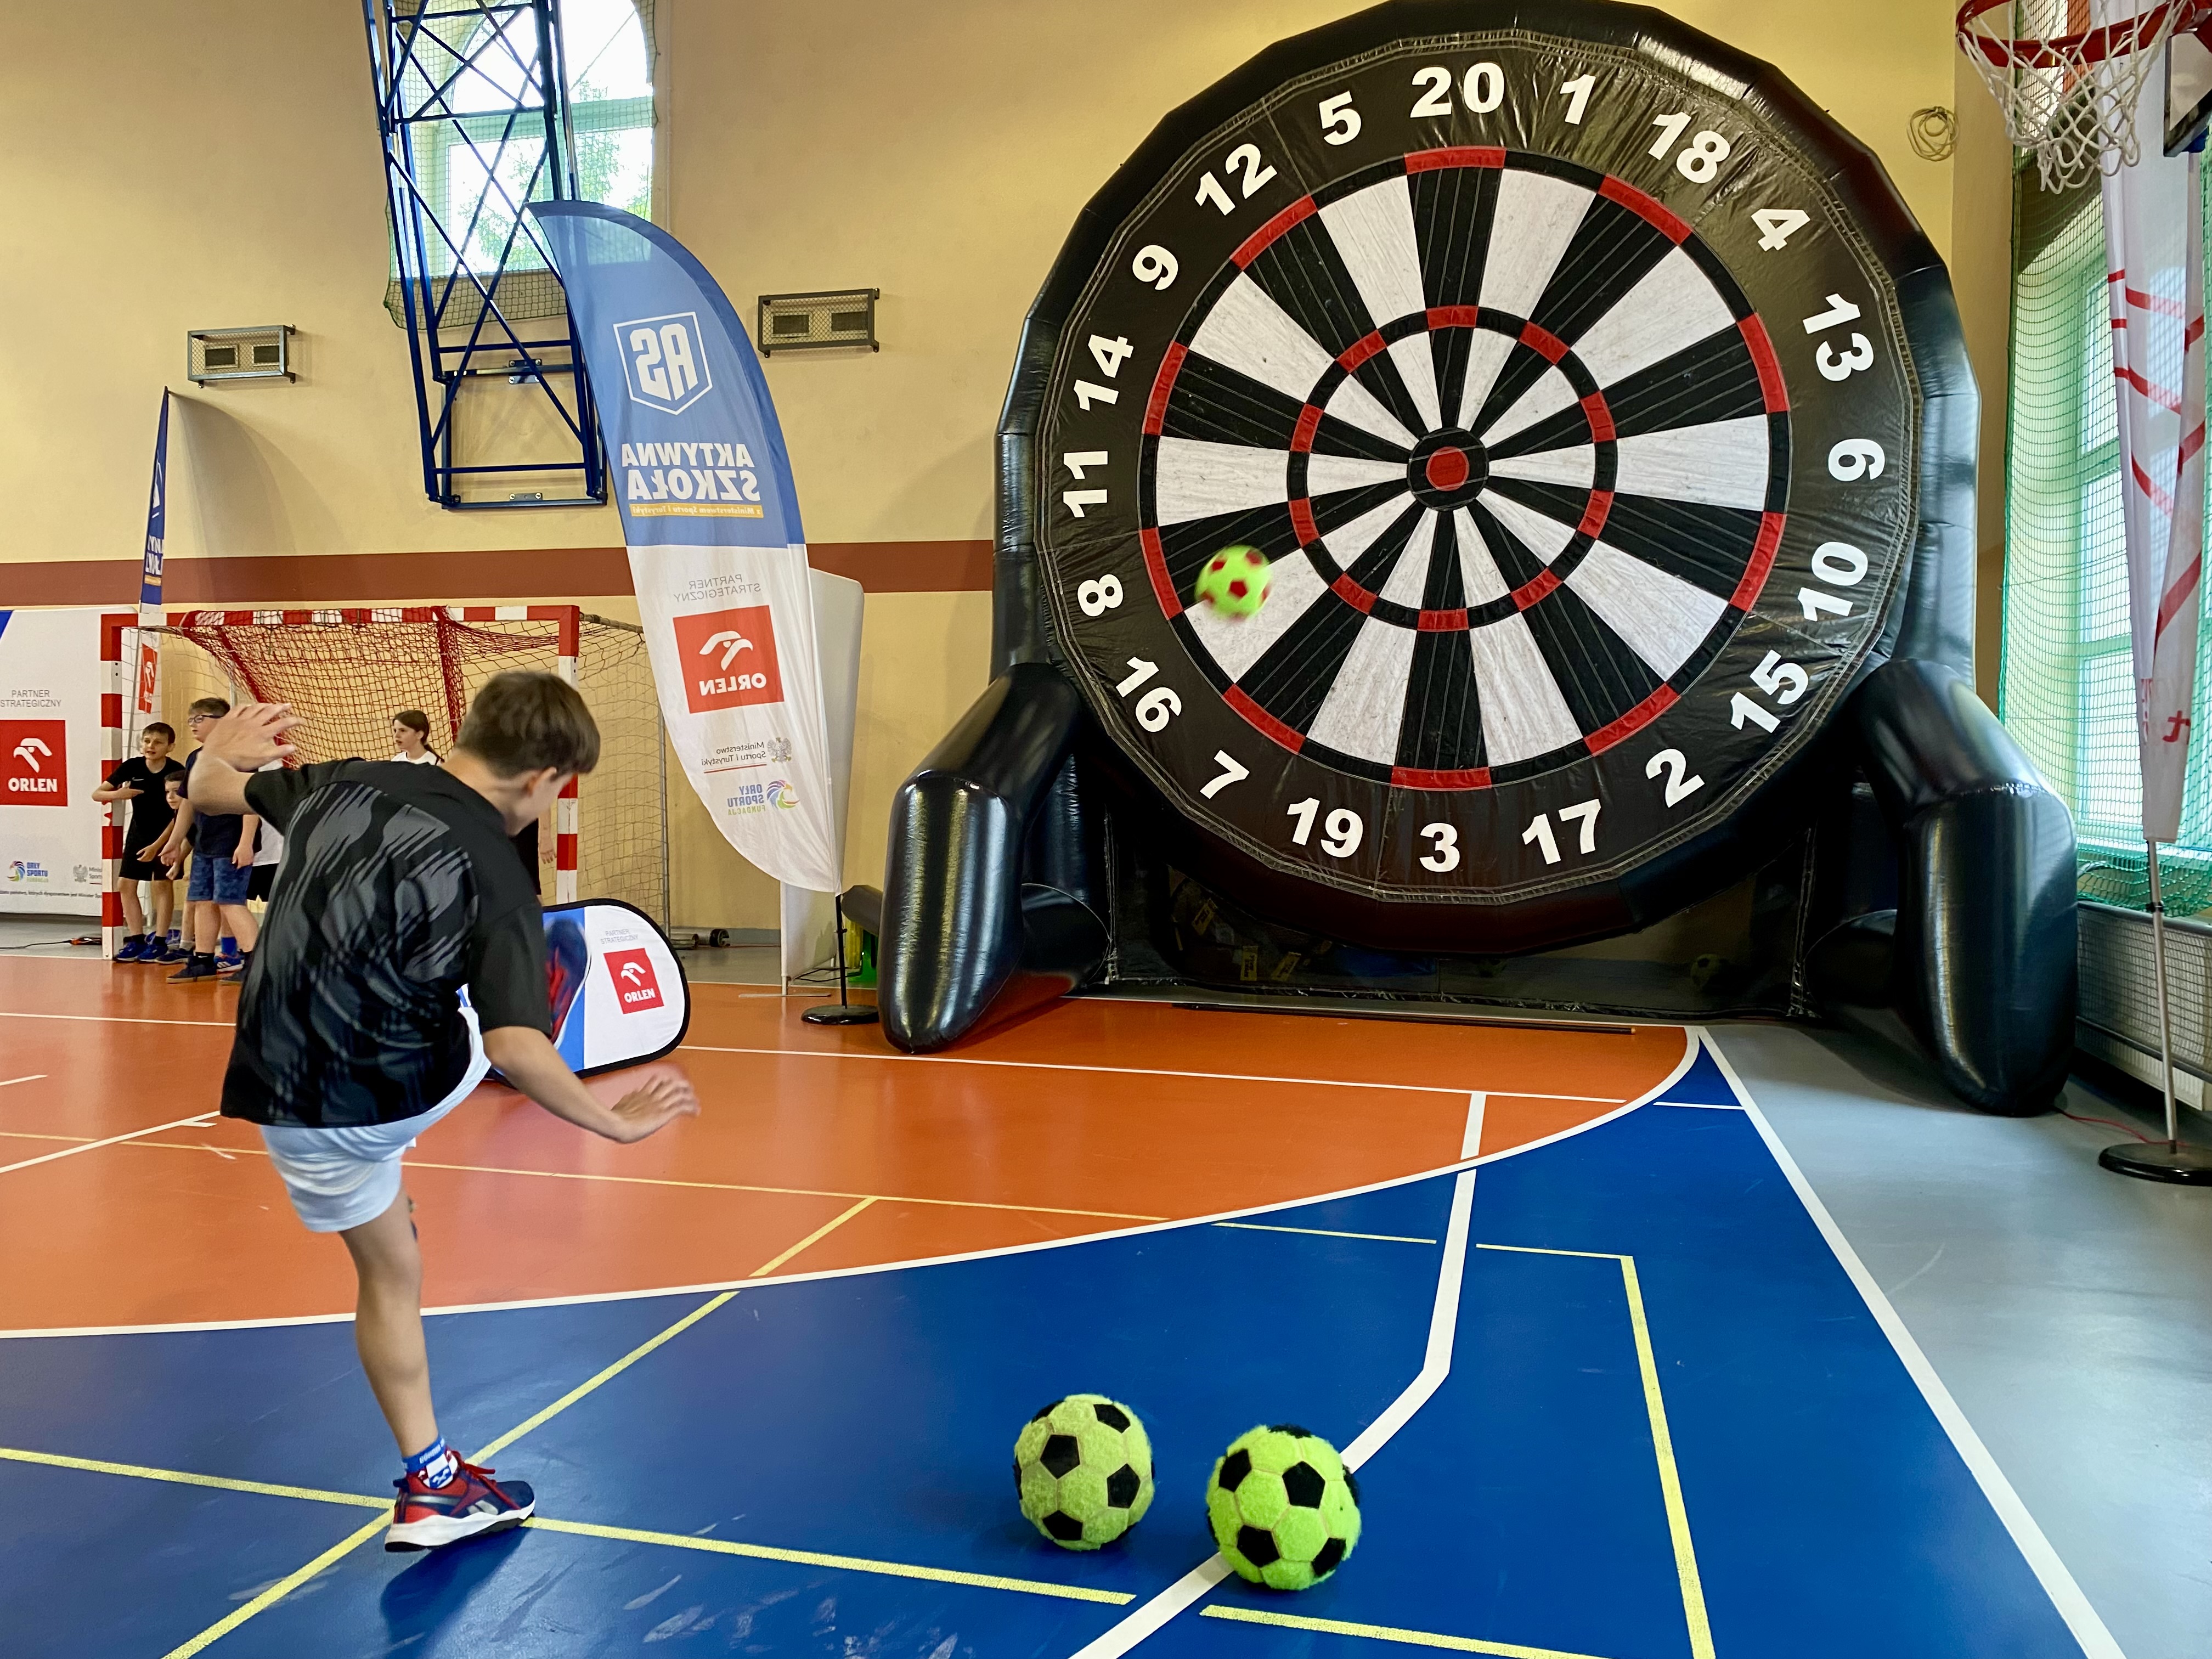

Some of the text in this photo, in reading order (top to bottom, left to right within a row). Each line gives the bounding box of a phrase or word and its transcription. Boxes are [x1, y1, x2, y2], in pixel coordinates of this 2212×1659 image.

[1410, 62, 1504, 118] 20
[1559, 72, 1596, 125] 1
[1319, 91, 1362, 145] 5
[1647, 110, 1730, 184] 18
[1194, 143, 1278, 216] 12
[1751, 208, 1810, 252] 4
[1132, 245, 1178, 290] 9
[1802, 293, 1874, 381] 13
[1073, 334, 1134, 411] 14
[1063, 450, 1108, 518] 11
[1077, 574, 1124, 617] 8
[1797, 541, 1869, 622] 10
[0, 699, 61, 708] STRATEGICZNY
[12, 690, 50, 698] PARTNER
[1115, 656, 1182, 732] 16
[1730, 649, 1809, 733] 15
[8, 777, 58, 792] ORLEN
[1199, 749, 1250, 799] 7
[1646, 748, 1705, 808] 2
[1286, 797, 1363, 857] 19
[1419, 822, 1460, 872] 3
[1522, 798, 1601, 865] 17
[600, 934, 639, 944] STRATEGICZNY
[624, 988, 656, 1003] ORLEN
